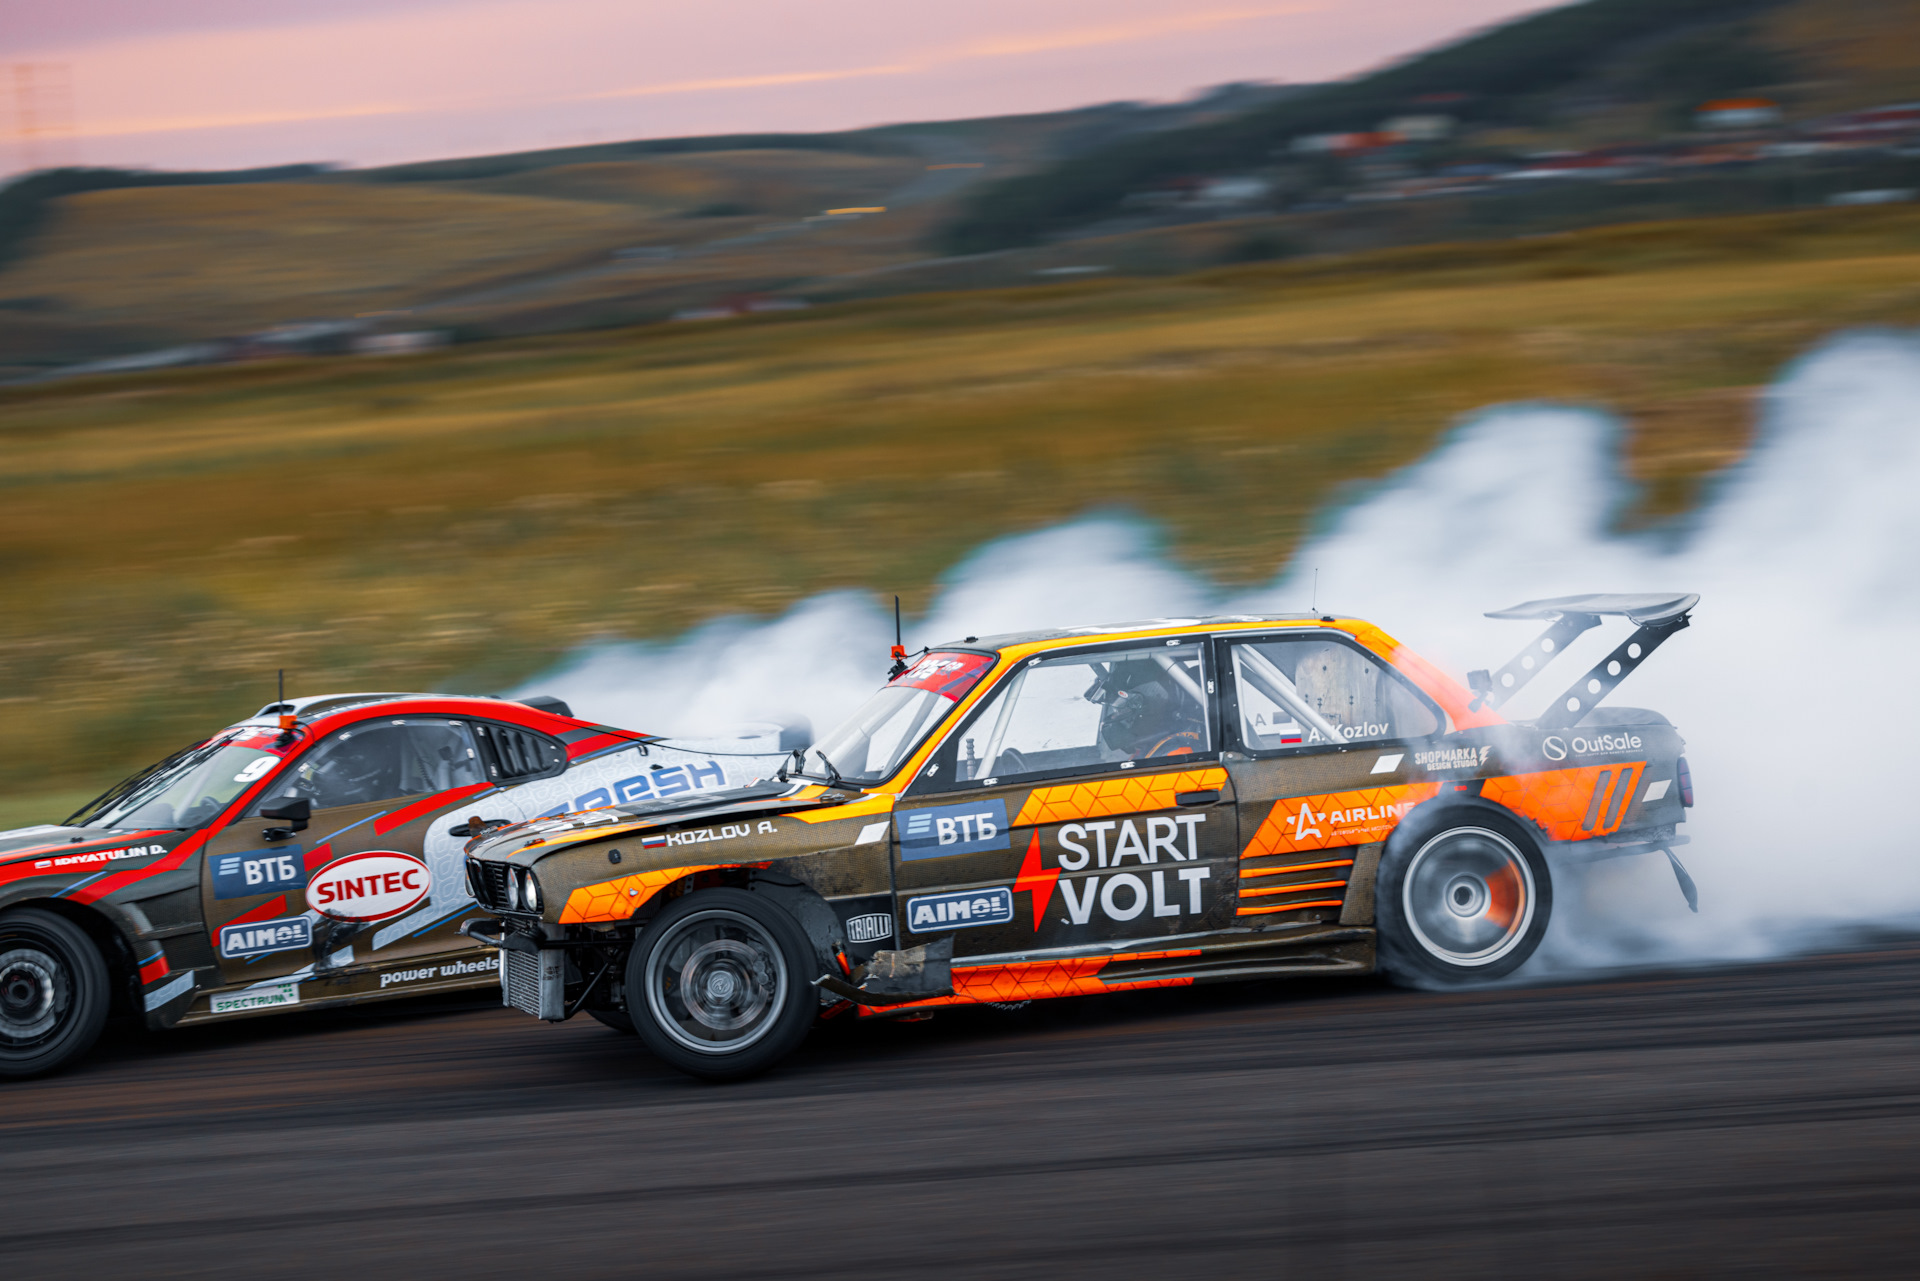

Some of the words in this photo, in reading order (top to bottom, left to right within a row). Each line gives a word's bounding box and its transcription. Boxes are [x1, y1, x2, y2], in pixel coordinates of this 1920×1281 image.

[1308, 727, 1325, 742] A.
[1332, 722, 1389, 742] Kozlov
[1572, 732, 1642, 753] OutSale
[233, 756, 281, 782] 9
[1415, 747, 1478, 765] SHOPMARKA
[1427, 762, 1452, 771] DESIGN
[1453, 759, 1478, 769] STUDIO
[666, 824, 751, 847] KOZLOV
[757, 821, 778, 834] A.
[936, 812, 998, 846] ВТБ
[1057, 813, 1206, 871] START
[55, 846, 147, 866] IDIYATULIN
[150, 844, 167, 855] D.
[244, 855, 297, 885] ВТБ
[316, 868, 420, 905] SINTEC
[1058, 867, 1210, 925] VOLT
[913, 896, 1008, 925] AIMOL
[226, 924, 308, 951] AIMOL
[849, 916, 889, 940] TRIALLI
[380, 966, 437, 988] power
[440, 957, 499, 976] wheels
[216, 993, 287, 1011] SPECTRUM
